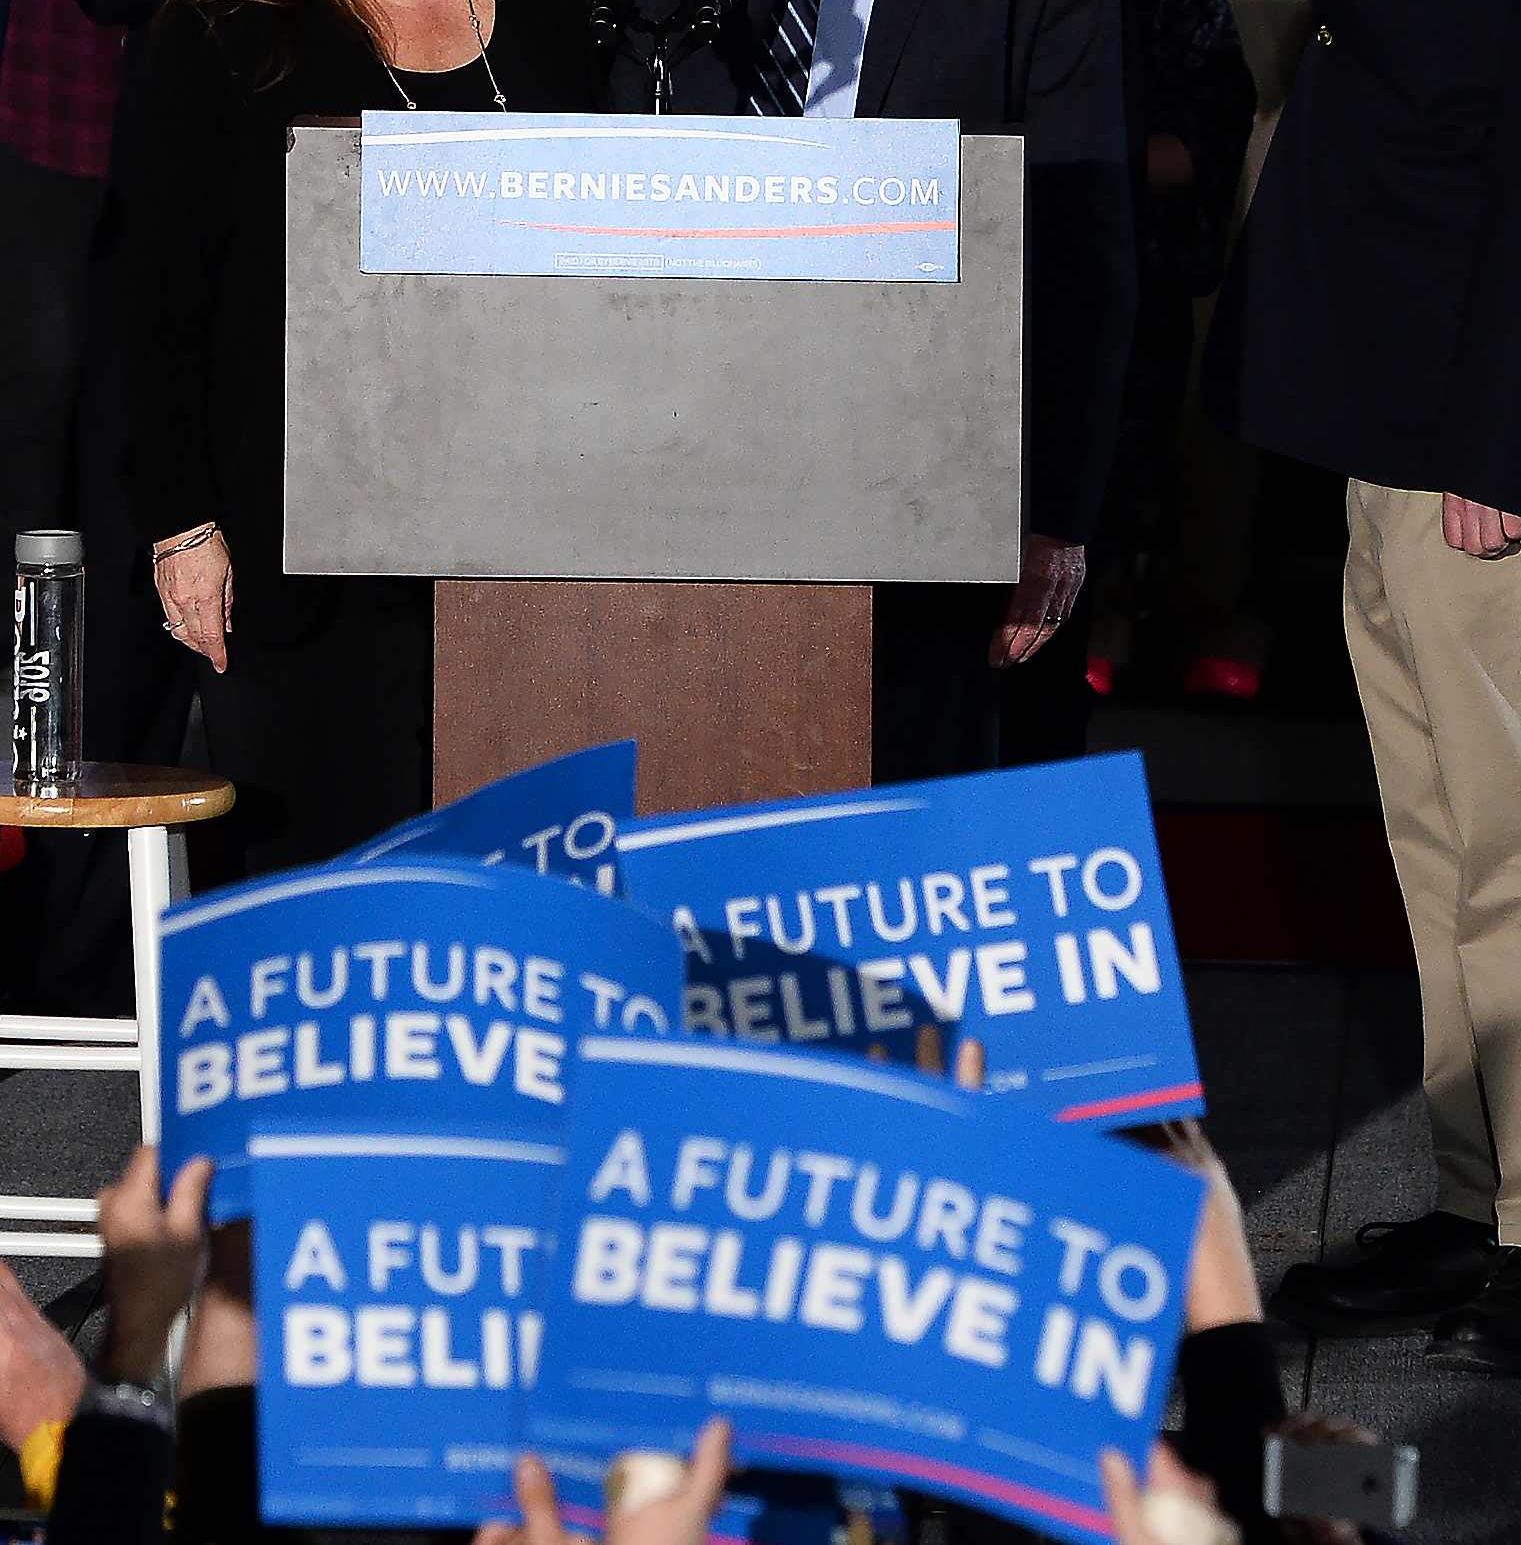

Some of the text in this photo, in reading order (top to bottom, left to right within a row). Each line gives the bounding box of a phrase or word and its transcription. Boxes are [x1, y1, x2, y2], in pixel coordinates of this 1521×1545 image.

[377, 168, 941, 207] WWW.BERNIESANDERS.COM
[522, 808, 617, 877] TO
[725, 844, 1144, 959] FUTURE TO
[176, 938, 673, 1038] A FUTURE TO
[686, 921, 1163, 1045] BELIEVE IN
[175, 1011, 568, 1117] BELIEVE
[284, 1218, 538, 1295] A FUT
[589, 1128, 1170, 1325] A FUTURE TO
[569, 1213, 1021, 1372] BELIEVE
[1032, 1300, 1159, 1422] IN
